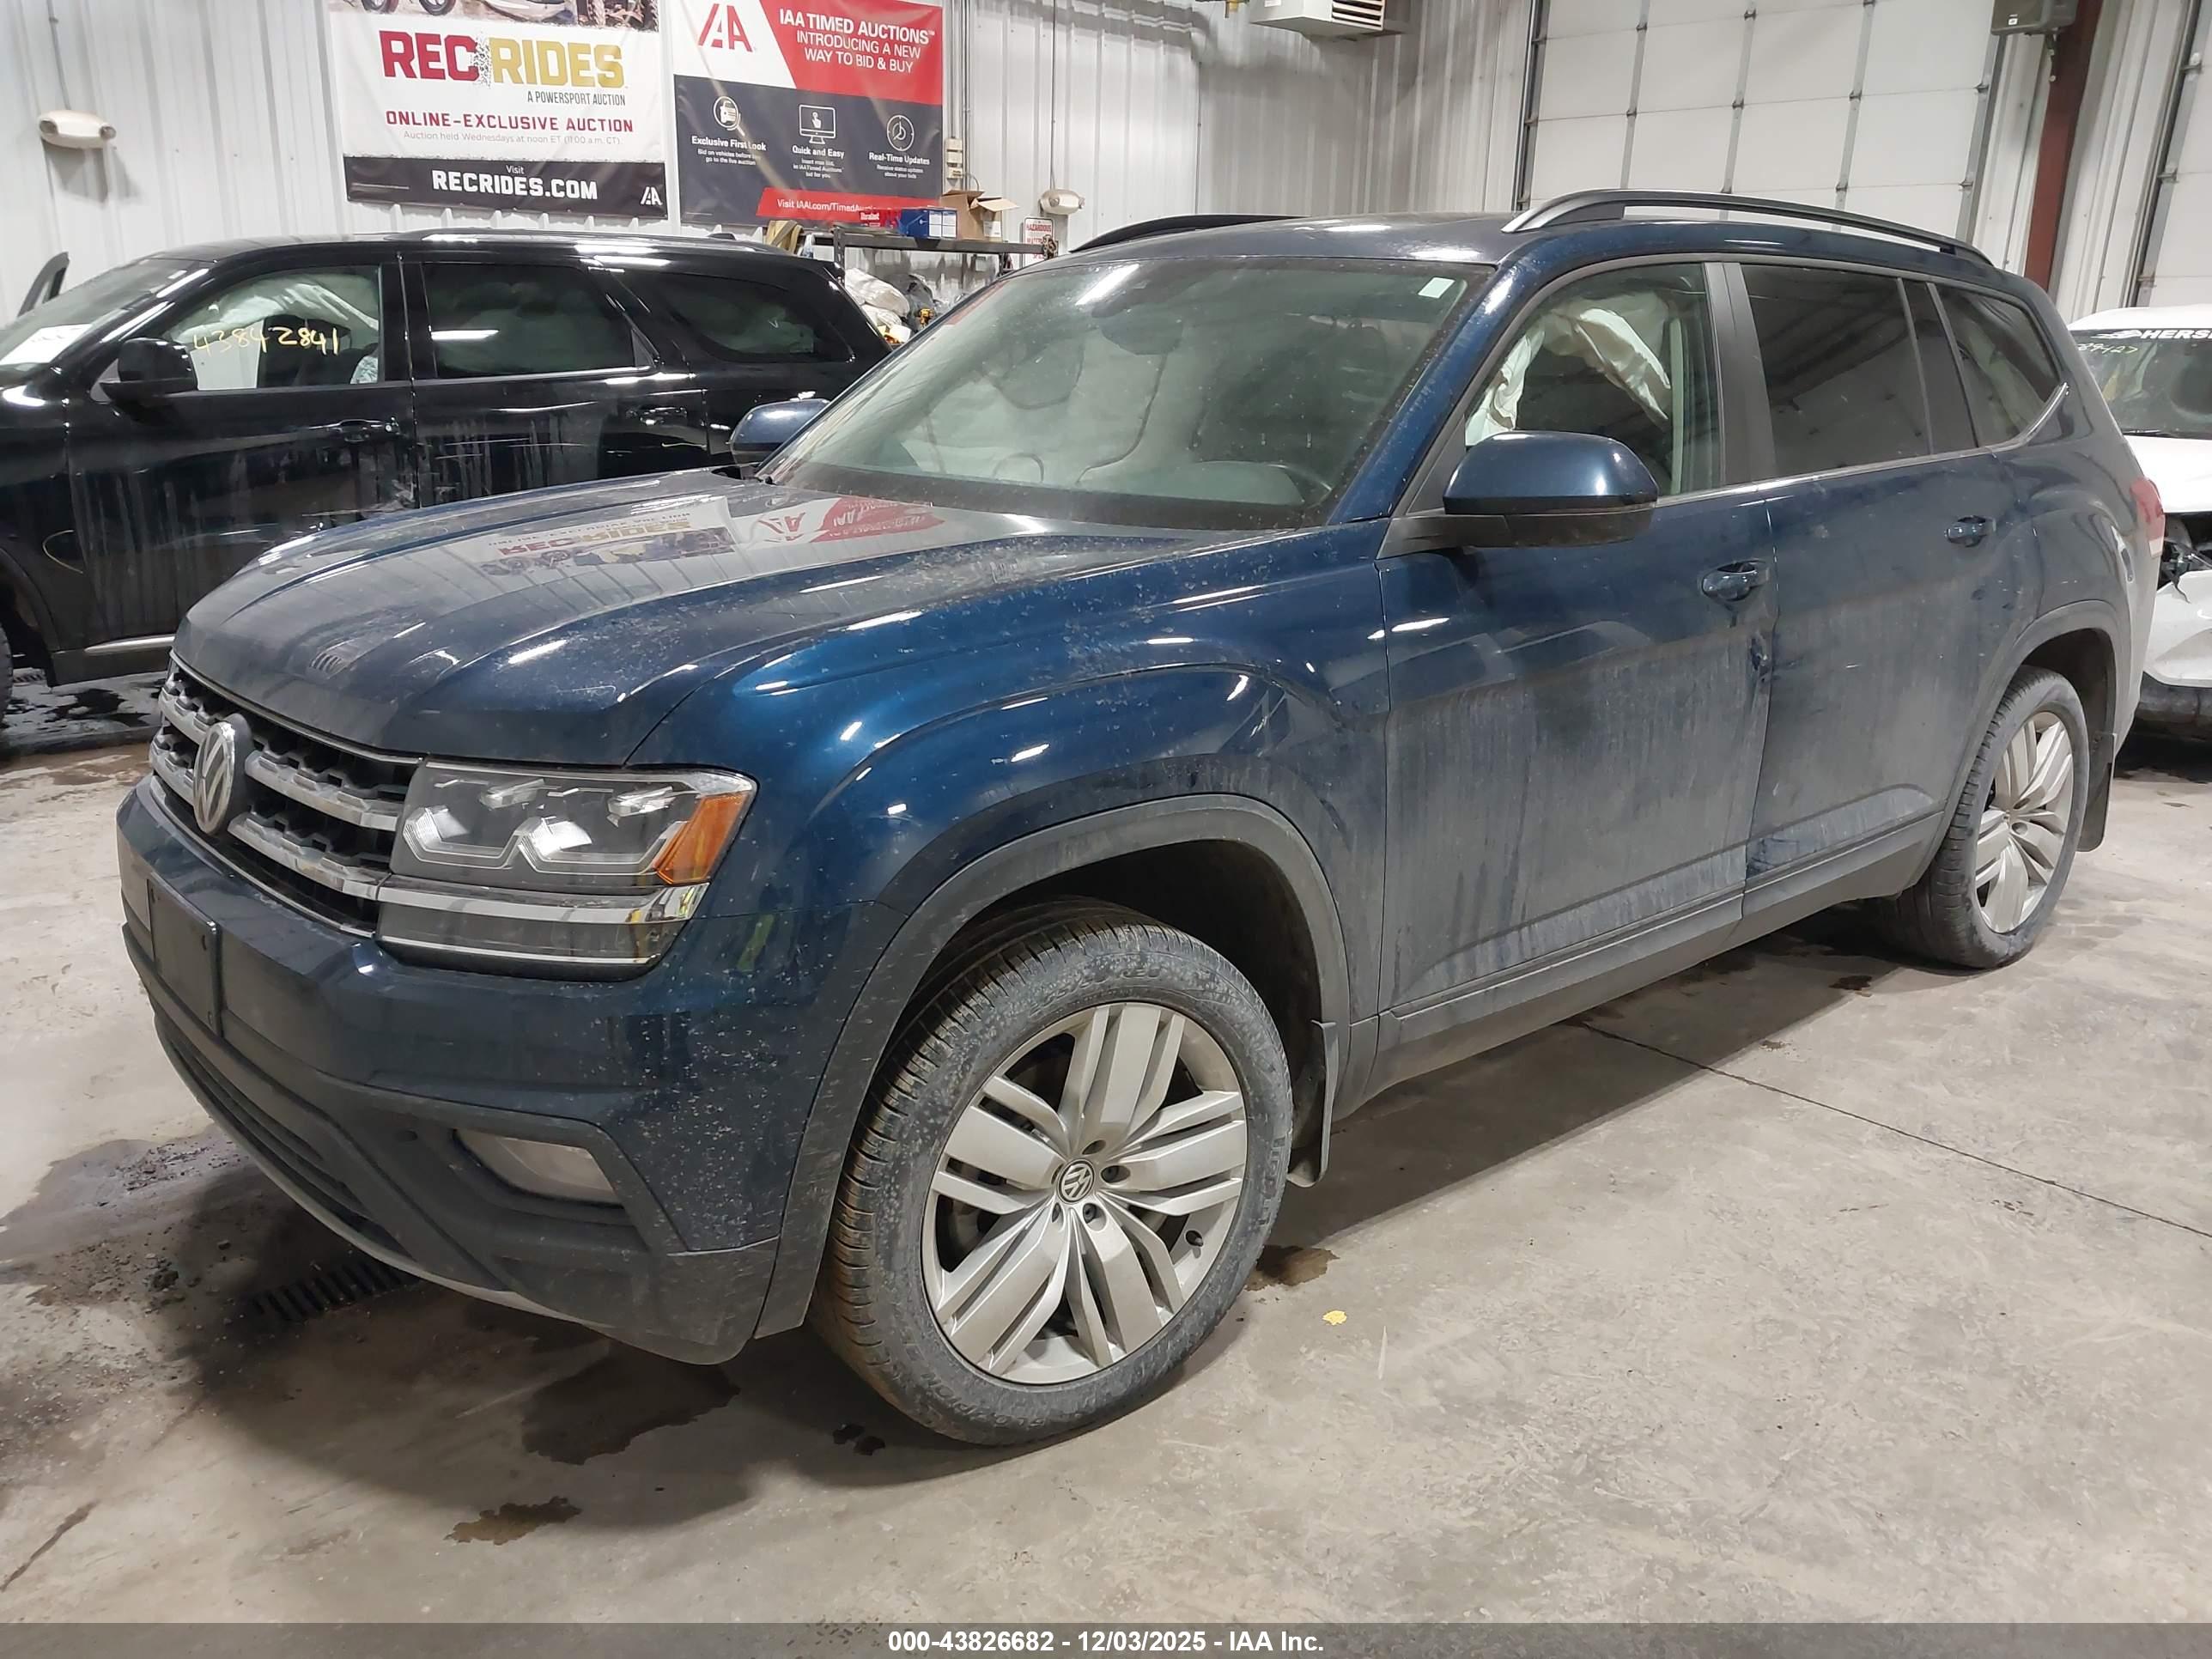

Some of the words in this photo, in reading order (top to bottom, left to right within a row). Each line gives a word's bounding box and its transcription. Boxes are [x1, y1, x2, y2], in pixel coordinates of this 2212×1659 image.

[780, 8, 805, 27] IAA
[806, 13, 854, 34] TIMED
[797, 30, 879, 54] INTRODUCING
[883, 45, 891, 56] A
[894, 46, 921, 59] NEW
[489, 37, 625, 88] RIDES
[805, 46, 833, 64] WAY
[836, 52, 853, 65] TO
[856, 55, 874, 69] BID
[877, 58, 886, 70] &
[890, 59, 913, 74] BUY
[527, 91, 534, 103] A
[536, 91, 591, 105] POWERSPORT
[592, 94, 626, 106] AUCTION
[386, 111, 560, 131] ONLINE-EXCLUSIVE
[566, 118, 634, 132] AUCTION
[404, 131, 439, 140] Auction
[440, 132, 459, 141] held
[461, 132, 514, 143] Wednesdays
[691, 136, 728, 147] Exclusive
[730, 139, 747, 149] First
[748, 141, 767, 151] Look
[793, 145, 811, 155] Quick
[827, 149, 845, 160] Easy
[869, 152, 903, 163] Real-Time
[904, 155, 930, 166] Updates
[506, 165, 525, 174] Visit
[432, 170, 598, 200] RECRIDES.COM
[777, 198, 794, 208] Visit
[2141, 329, 2212, 339] HERS
